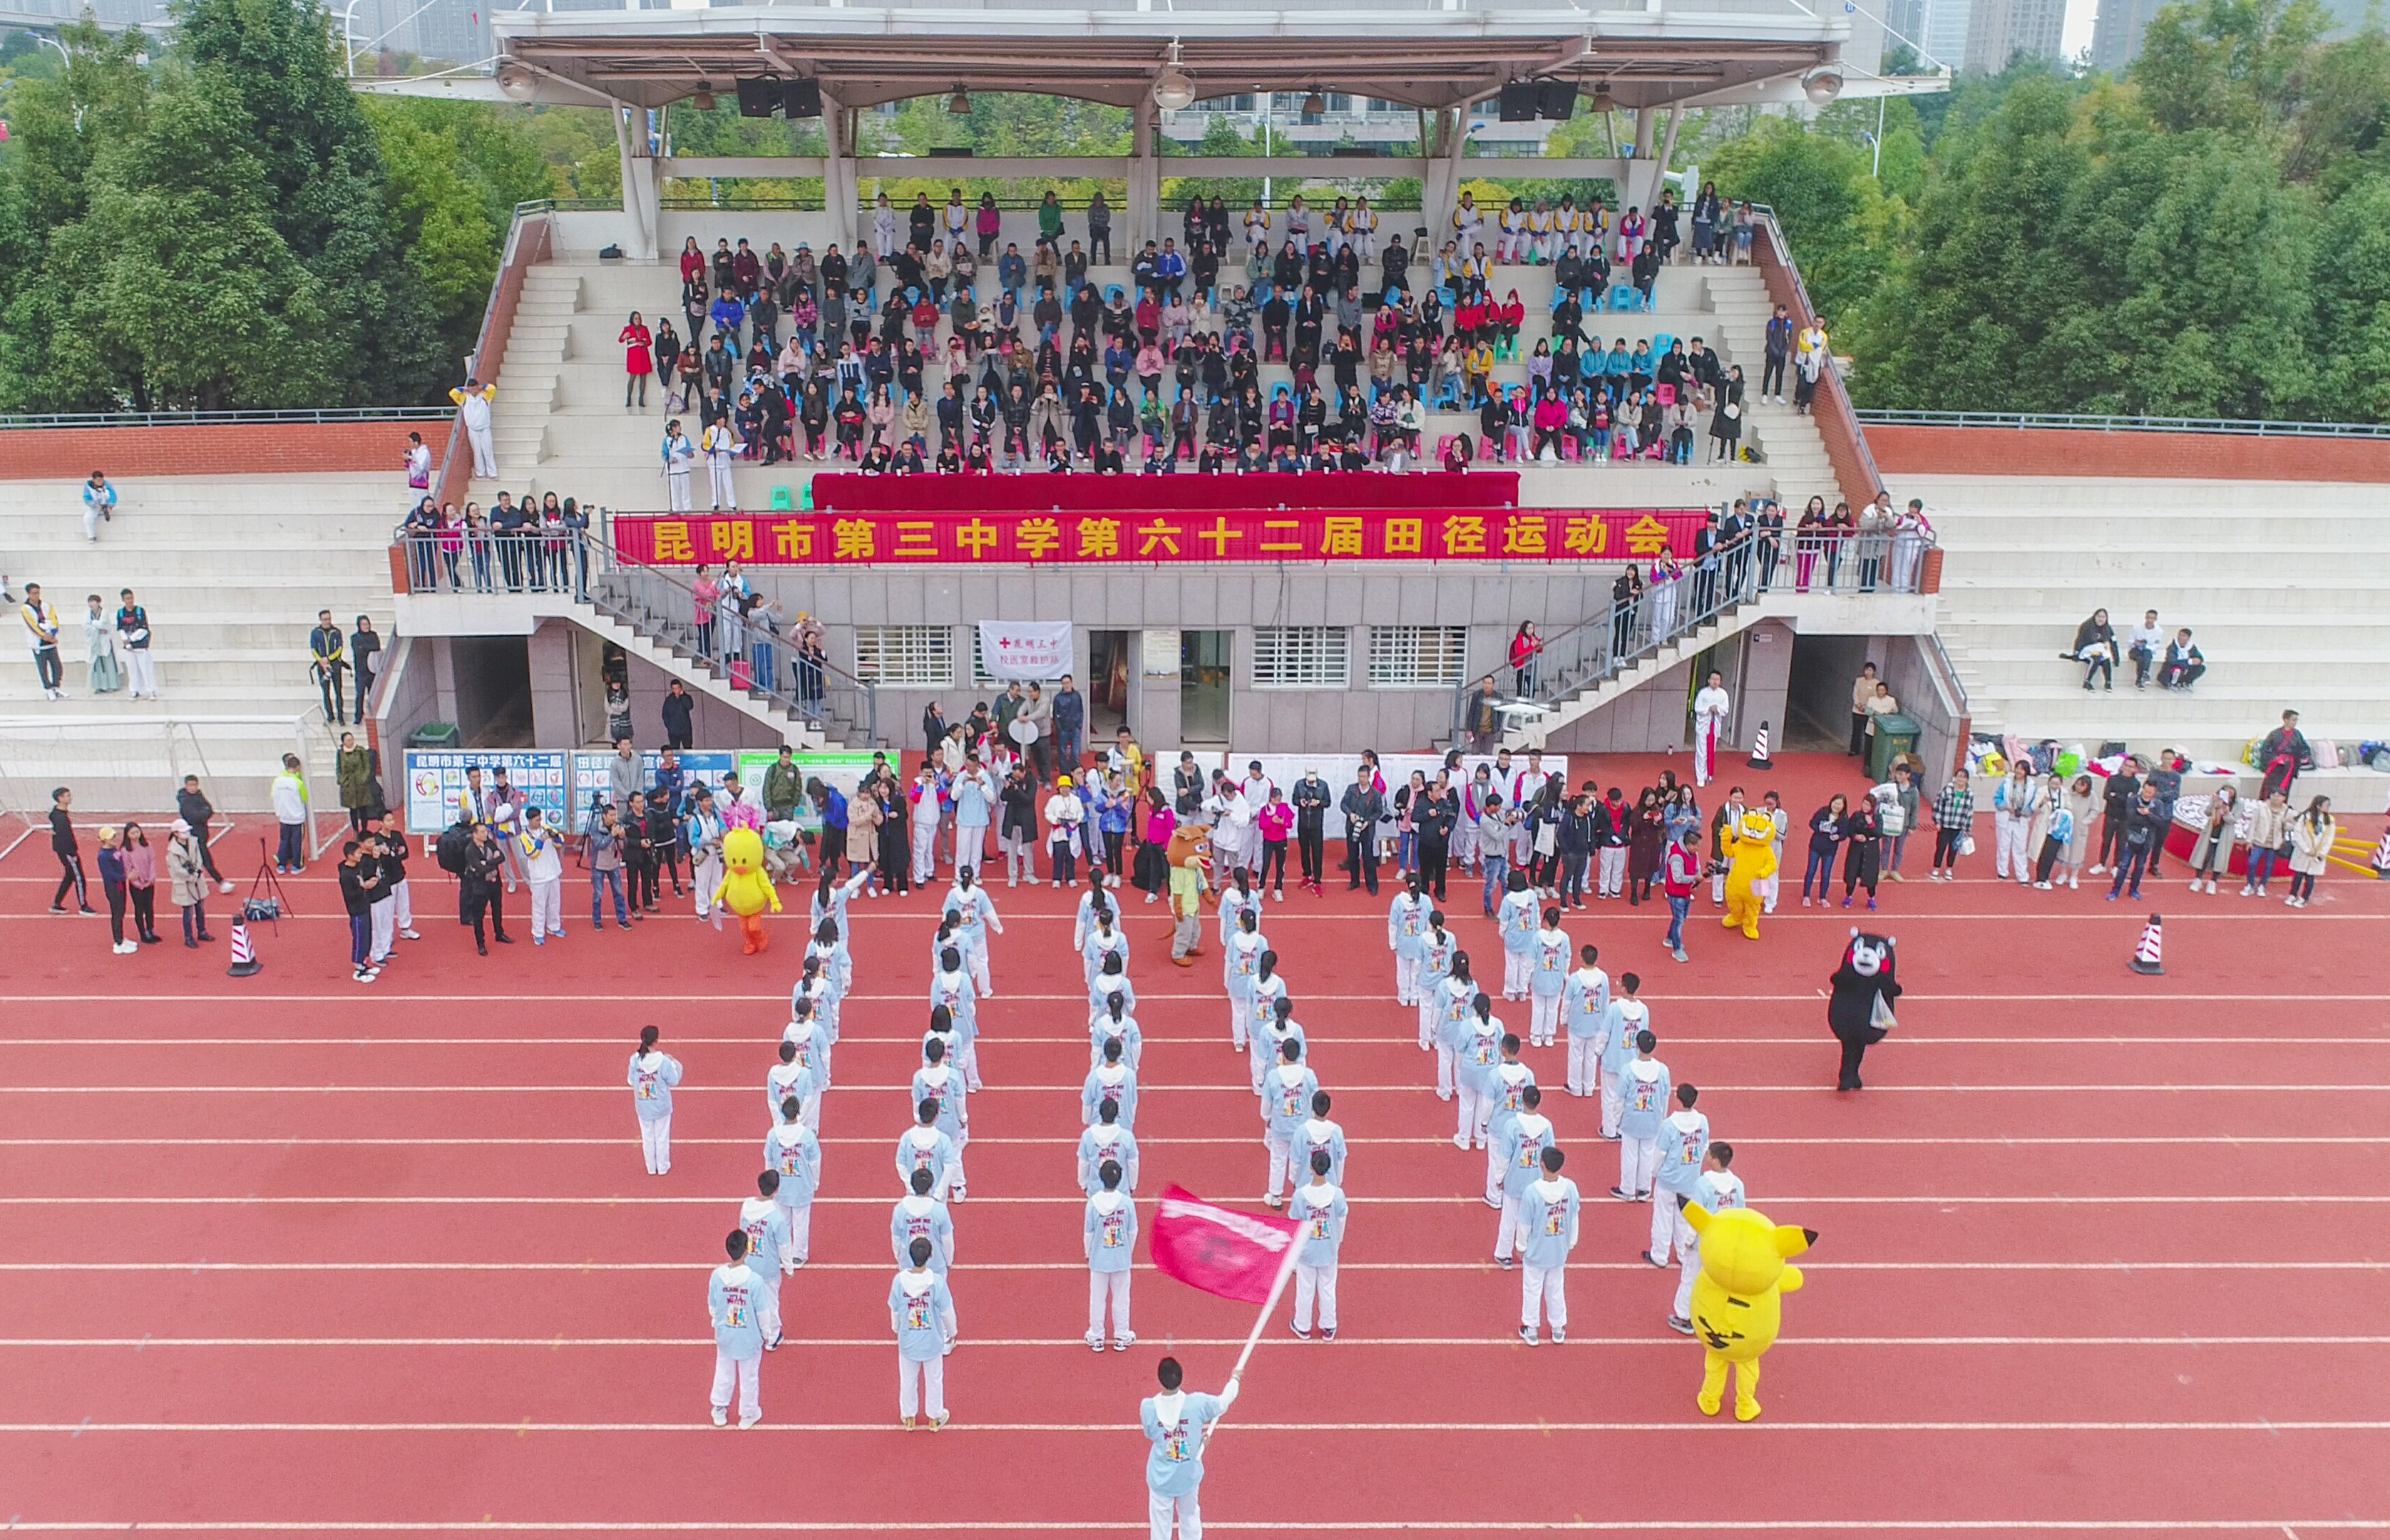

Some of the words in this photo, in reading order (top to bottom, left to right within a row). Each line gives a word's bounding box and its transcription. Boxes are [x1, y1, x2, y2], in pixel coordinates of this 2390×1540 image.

[653, 515, 1668, 560] 昆明市第三中学第六十二届田径运动会
[1014, 639, 1058, 650] 昆明三中
[1000, 654, 1059, 664] 校医室救护站
[416, 754, 562, 768] 昆明市第三中学第六十二届
